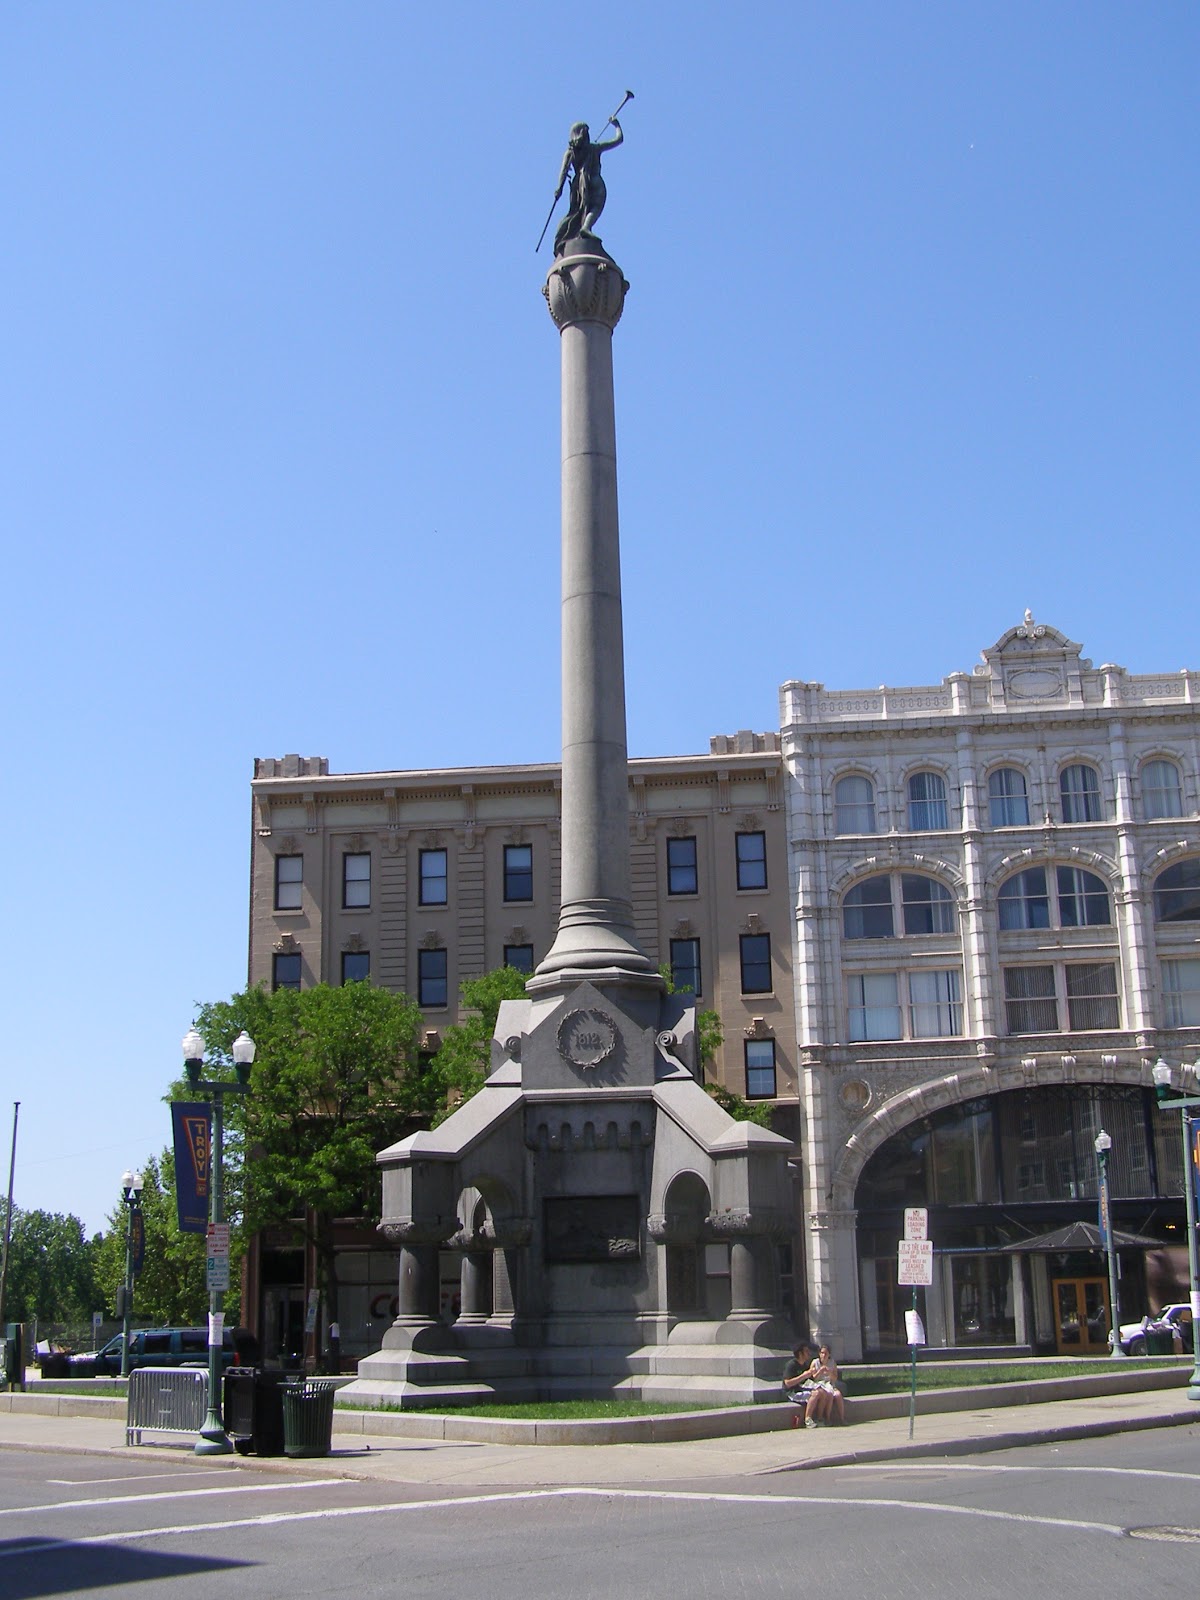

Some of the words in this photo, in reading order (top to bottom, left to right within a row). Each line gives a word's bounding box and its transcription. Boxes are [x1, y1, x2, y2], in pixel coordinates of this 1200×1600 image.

[575, 1032, 599, 1046] 1812
[195, 1123, 205, 1171] TROY
[911, 1243, 920, 1251] THE
